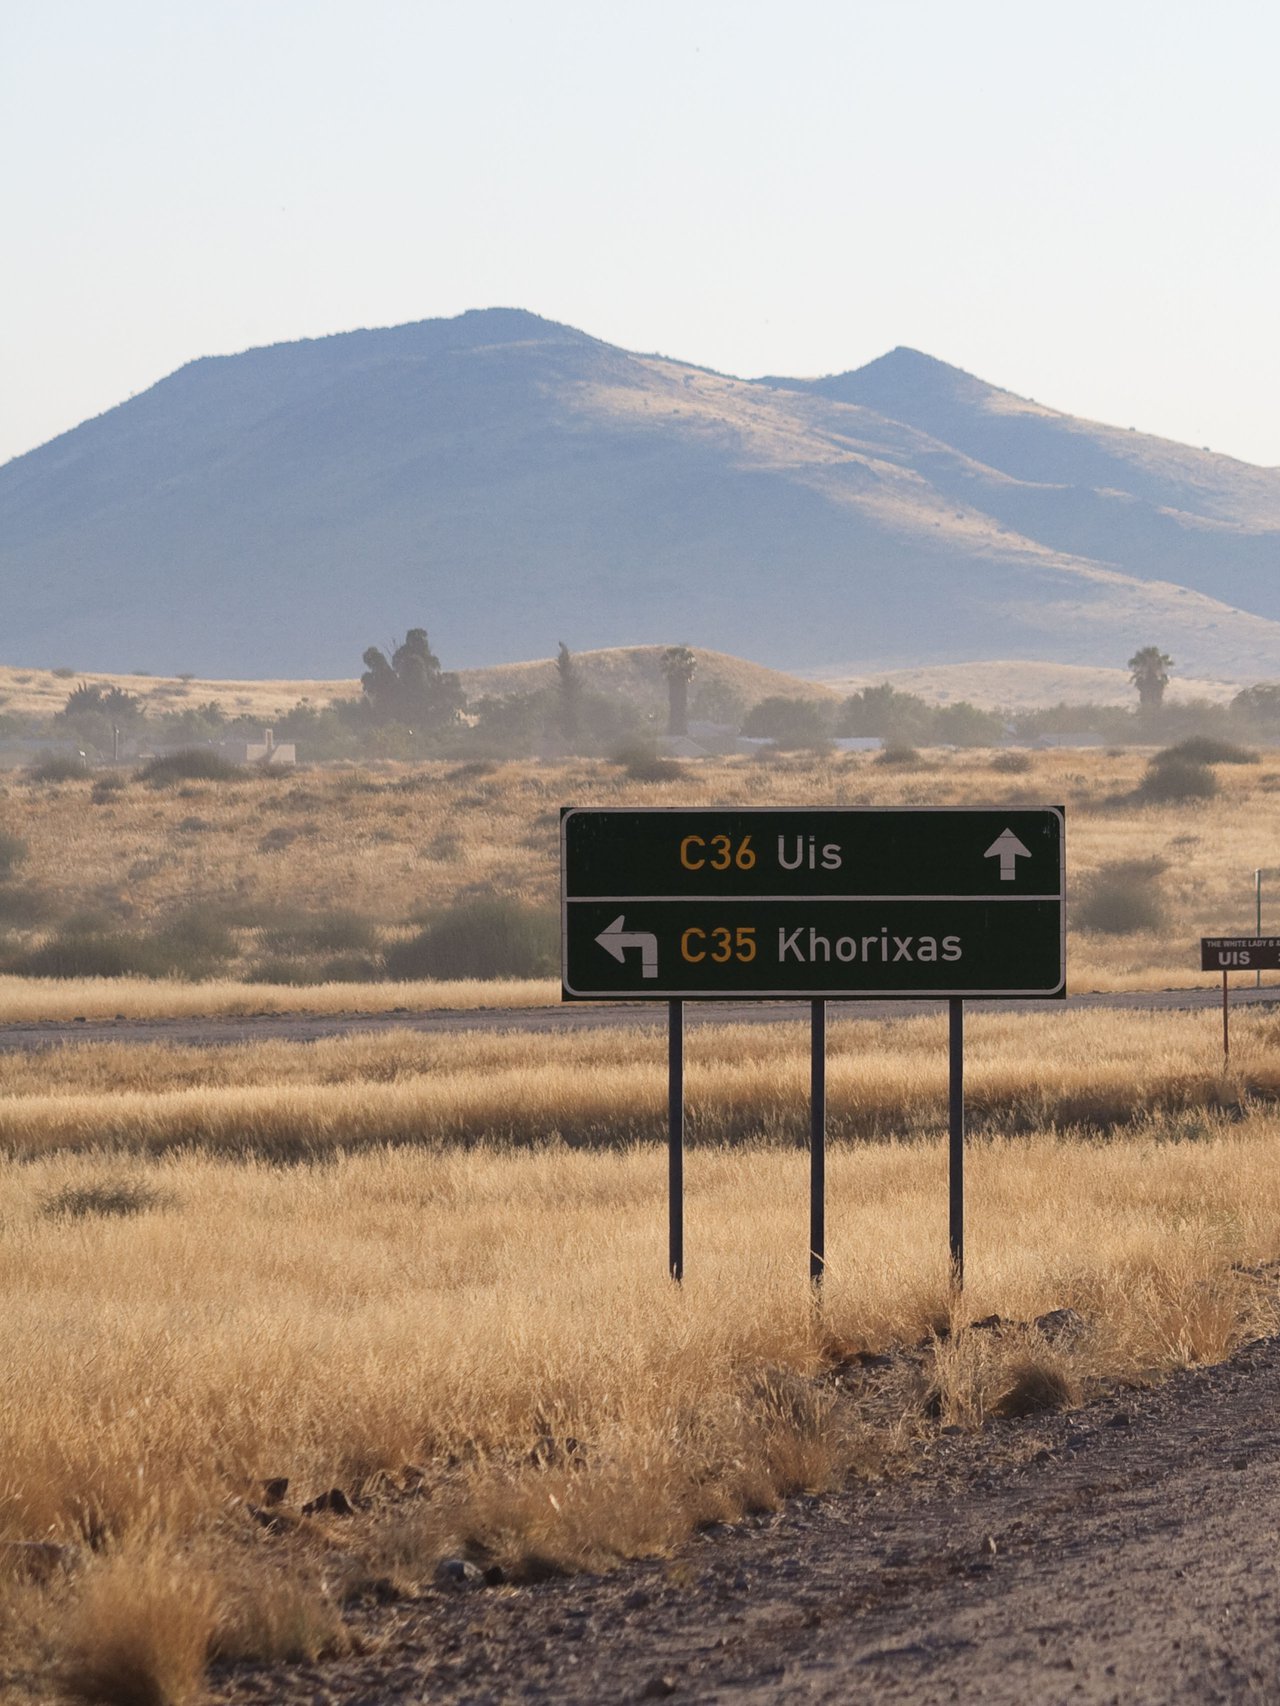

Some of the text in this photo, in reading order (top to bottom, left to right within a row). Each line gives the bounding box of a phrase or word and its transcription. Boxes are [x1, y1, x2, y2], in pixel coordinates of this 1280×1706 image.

[680, 835, 843, 870] C36 Uis
[680, 927, 963, 962] C35 Khorixas
[1207, 940, 1221, 948] THE
[1223, 940, 1247, 948] WHITE
[1248, 939, 1267, 947] LADY
[1218, 951, 1251, 965] UIS
